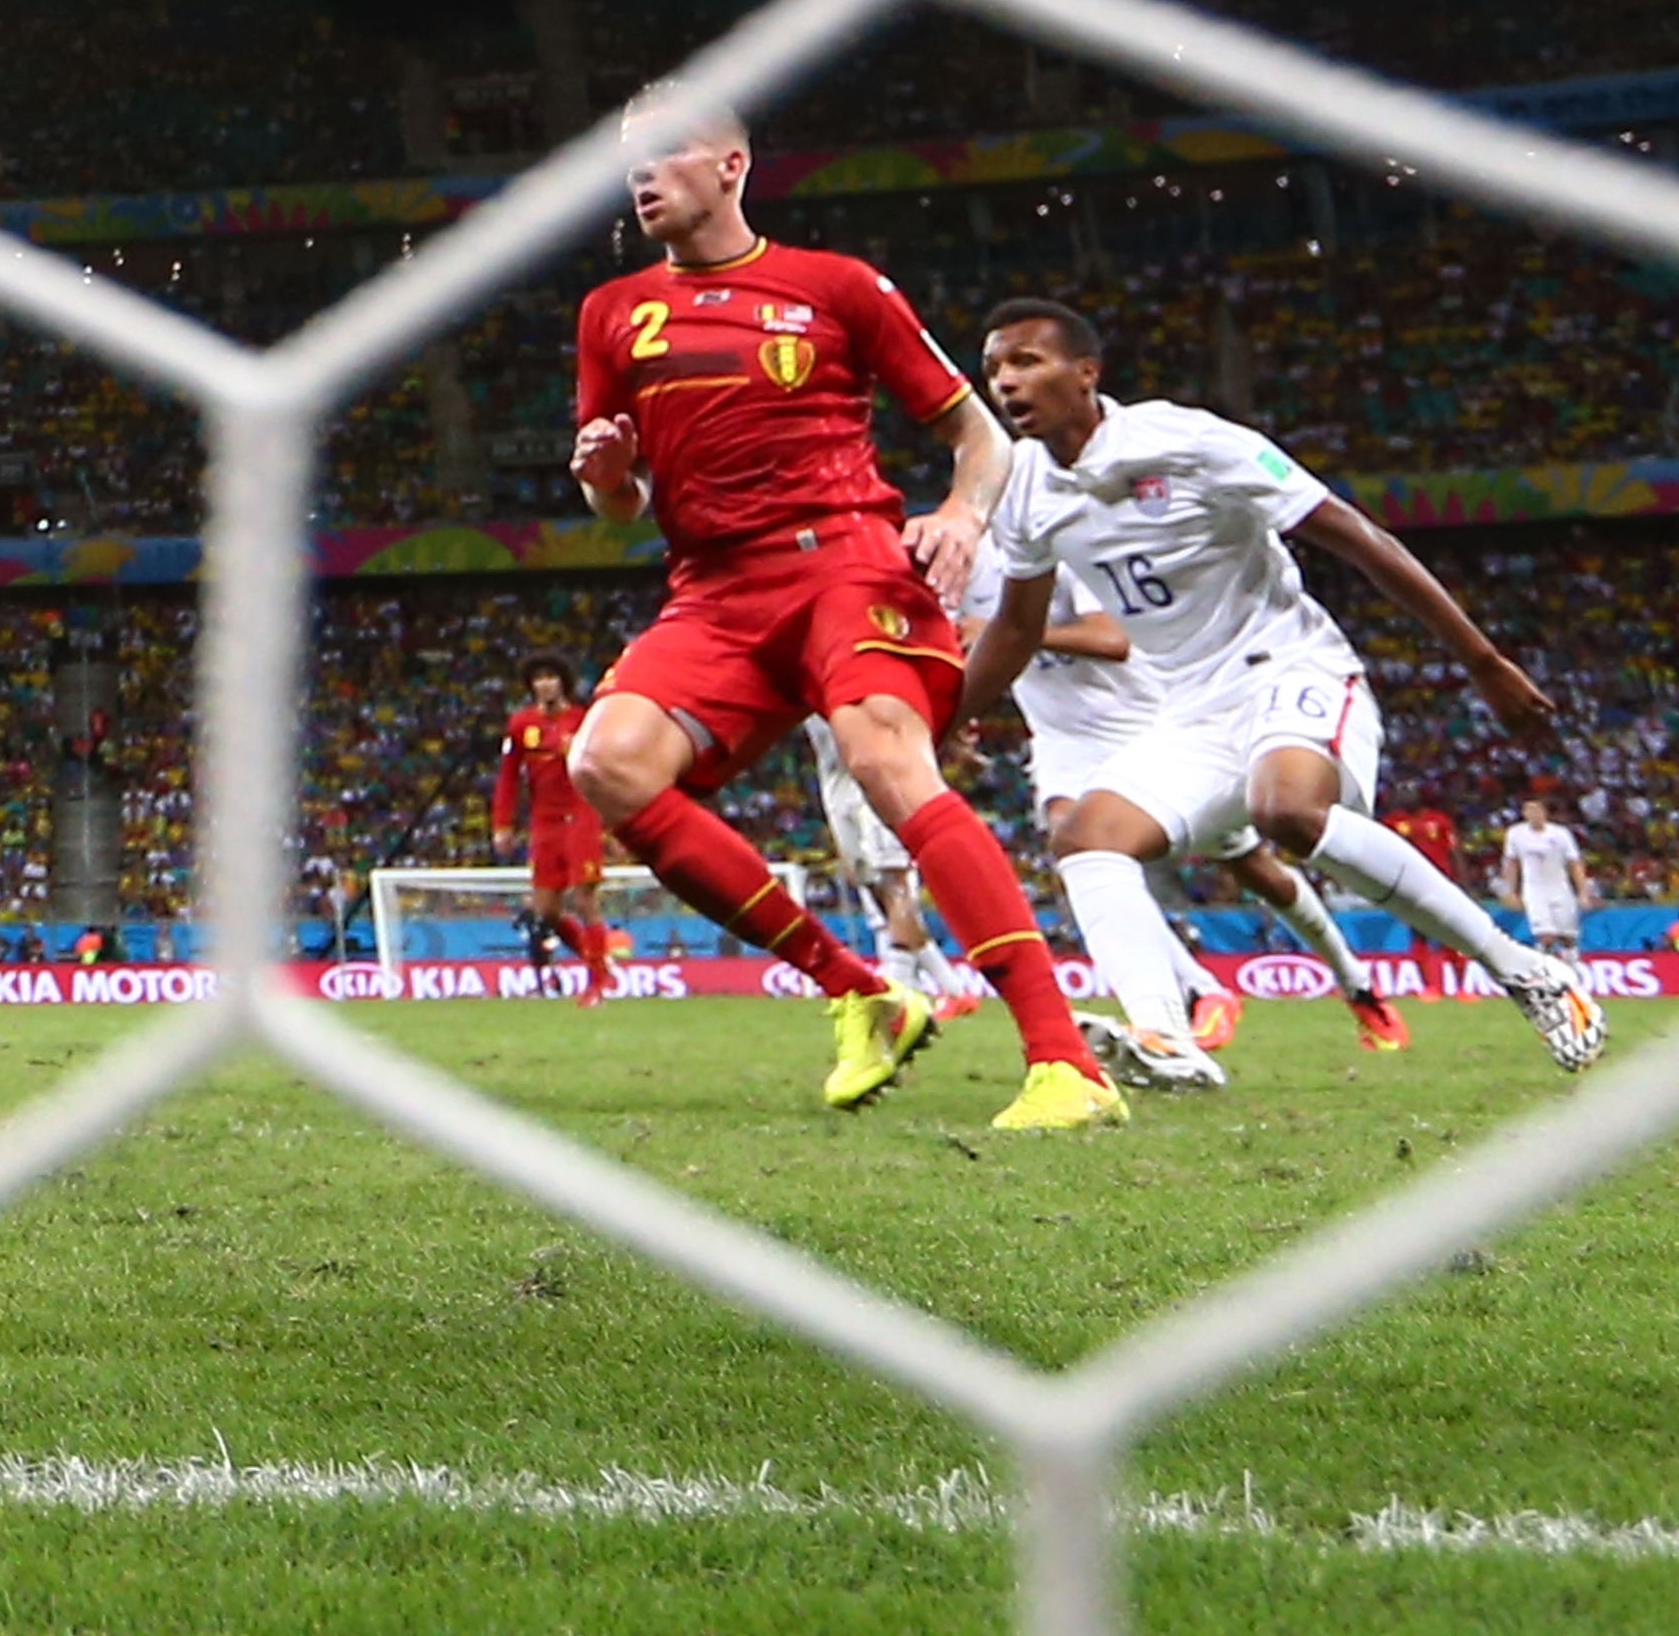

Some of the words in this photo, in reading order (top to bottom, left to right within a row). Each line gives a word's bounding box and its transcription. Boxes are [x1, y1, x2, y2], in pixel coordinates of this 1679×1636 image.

[630, 301, 670, 359] 2
[1095, 554, 1173, 615] 16
[1265, 685, 1330, 719] 16
[72, 968, 219, 1004] MOTOR
[410, 966, 485, 1000] KIA
[1367, 963, 1425, 996] IA
